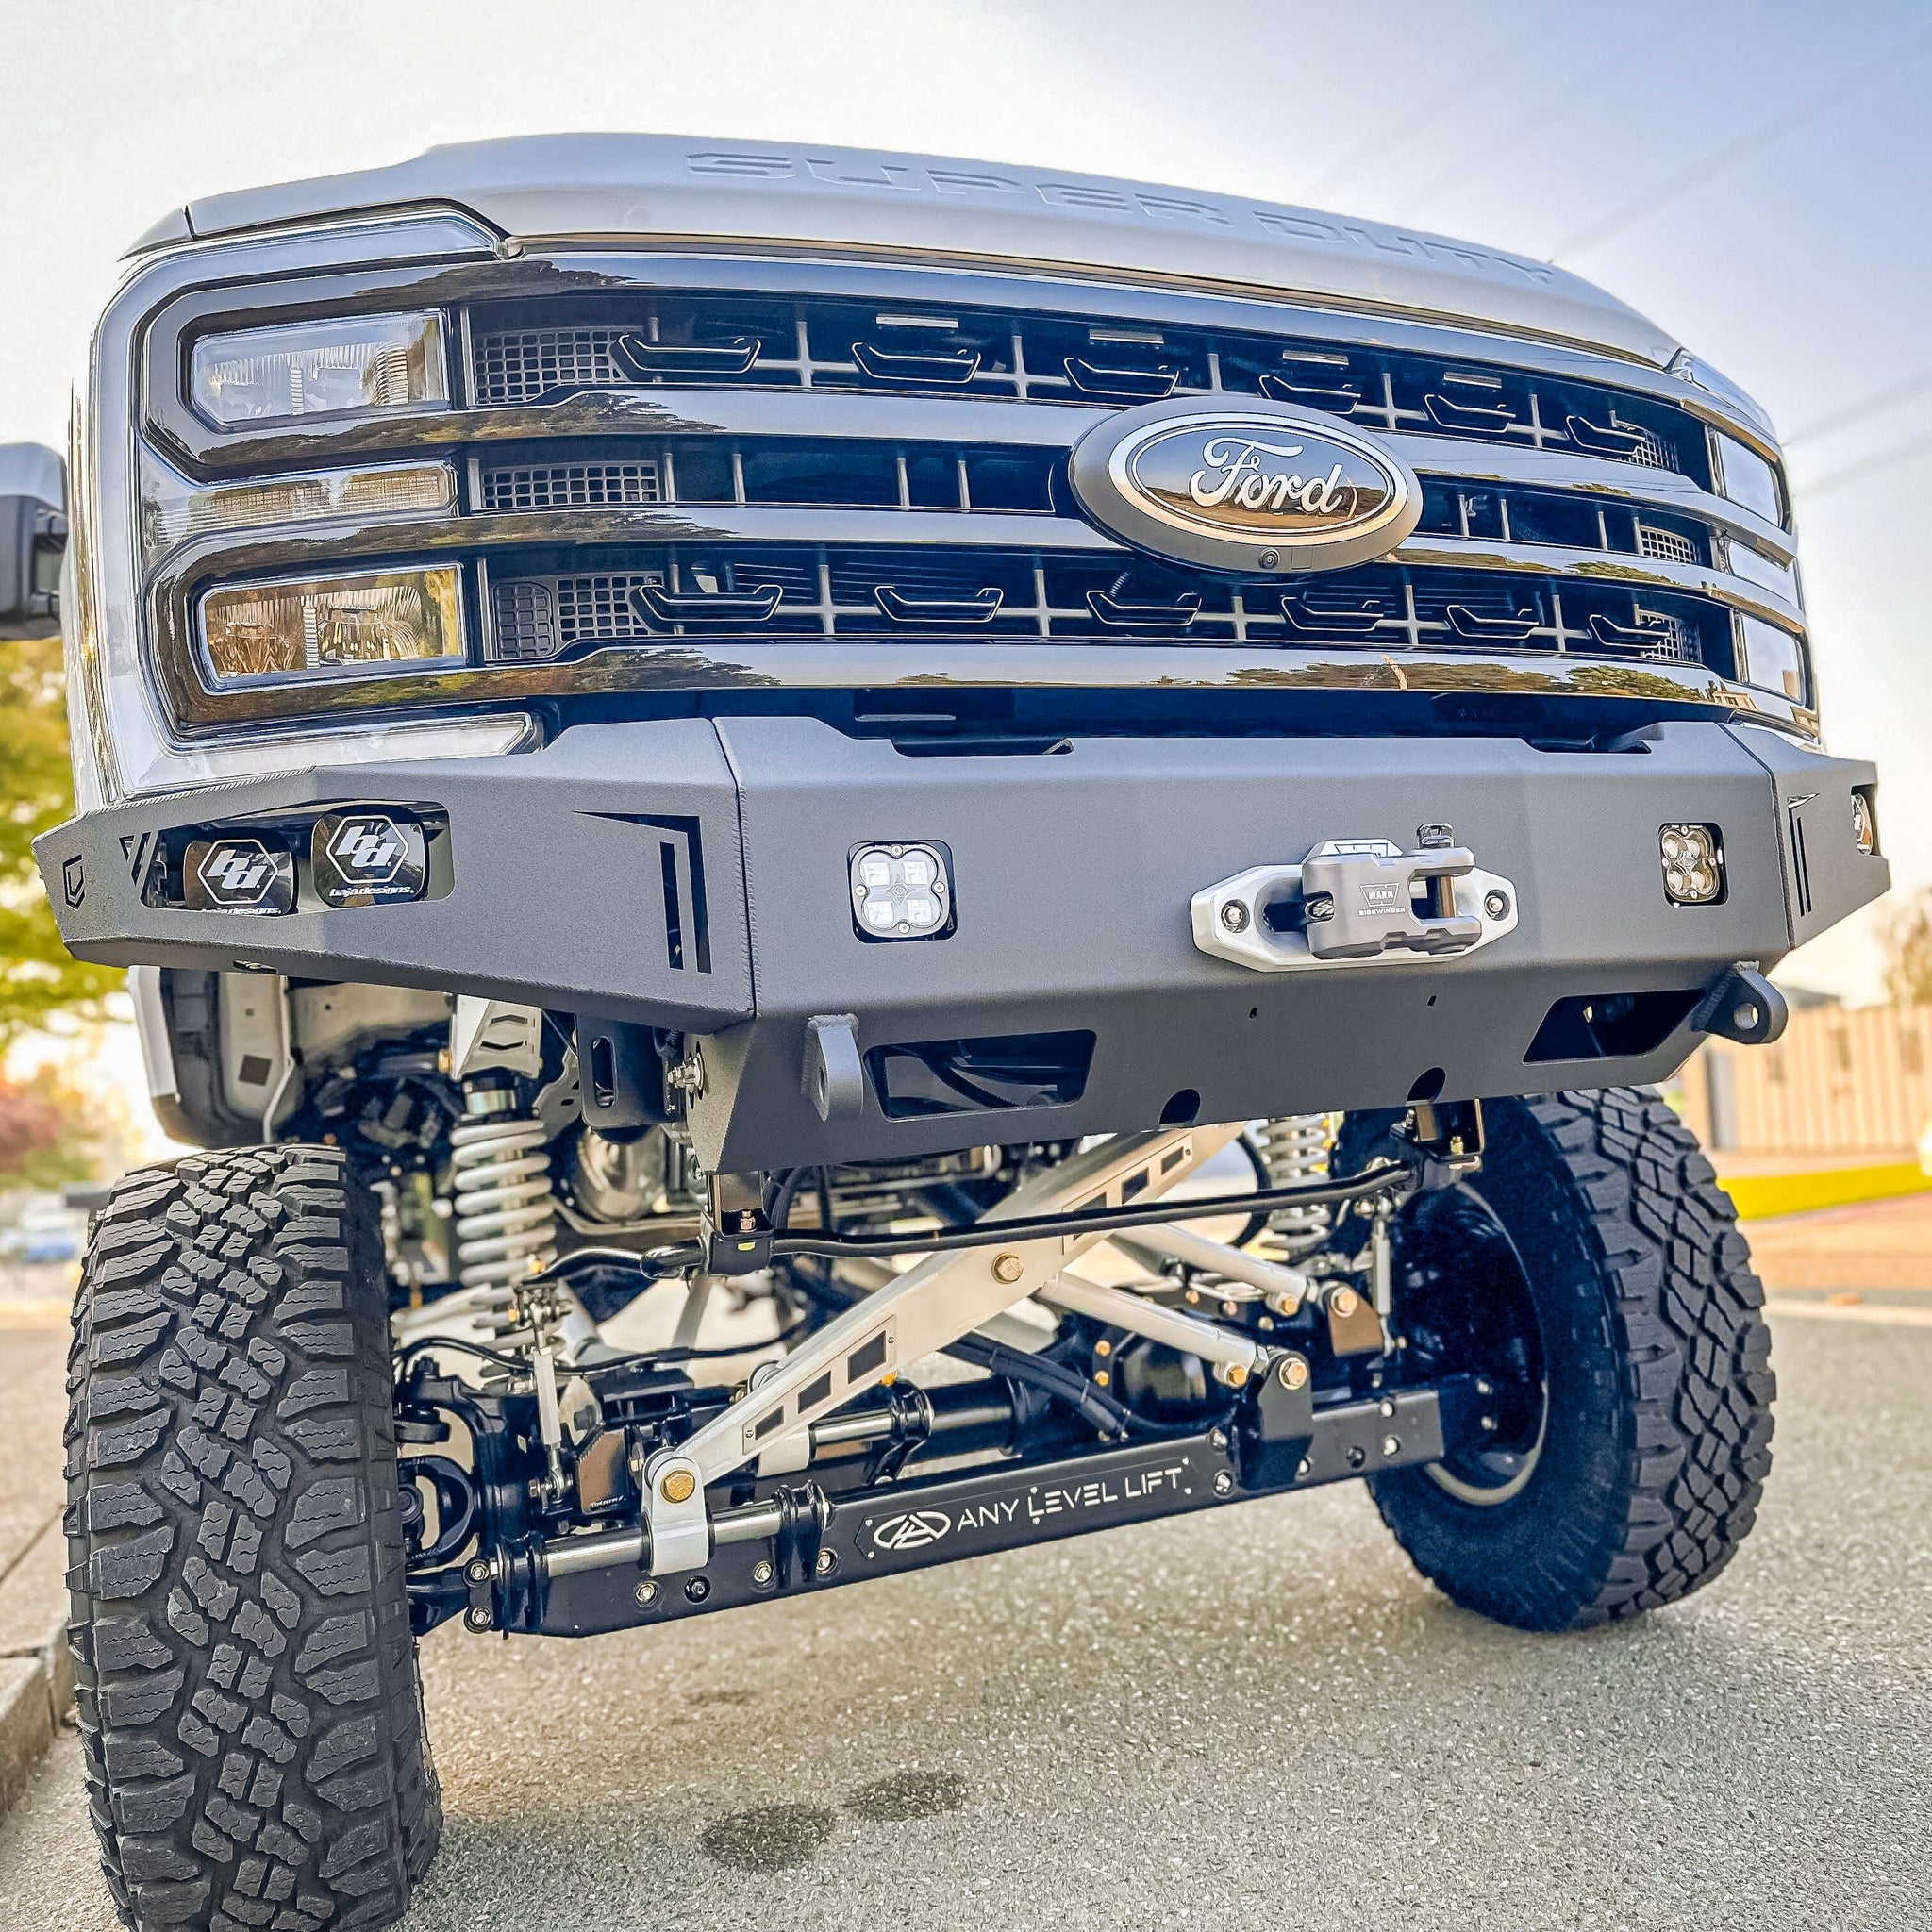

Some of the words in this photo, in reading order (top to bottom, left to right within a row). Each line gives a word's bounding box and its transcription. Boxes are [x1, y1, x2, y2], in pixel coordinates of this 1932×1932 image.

[685, 151, 1234, 228] SUPER
[1251, 209, 1555, 285] DUTY
[1188, 437, 1343, 514] Ford
[329, 888, 358, 898] baja
[1368, 890, 1394, 900] WARN
[957, 1498, 1020, 1533] ANY
[1027, 1482, 1119, 1518] LEVEL
[1124, 1467, 1183, 1499] LIFT
